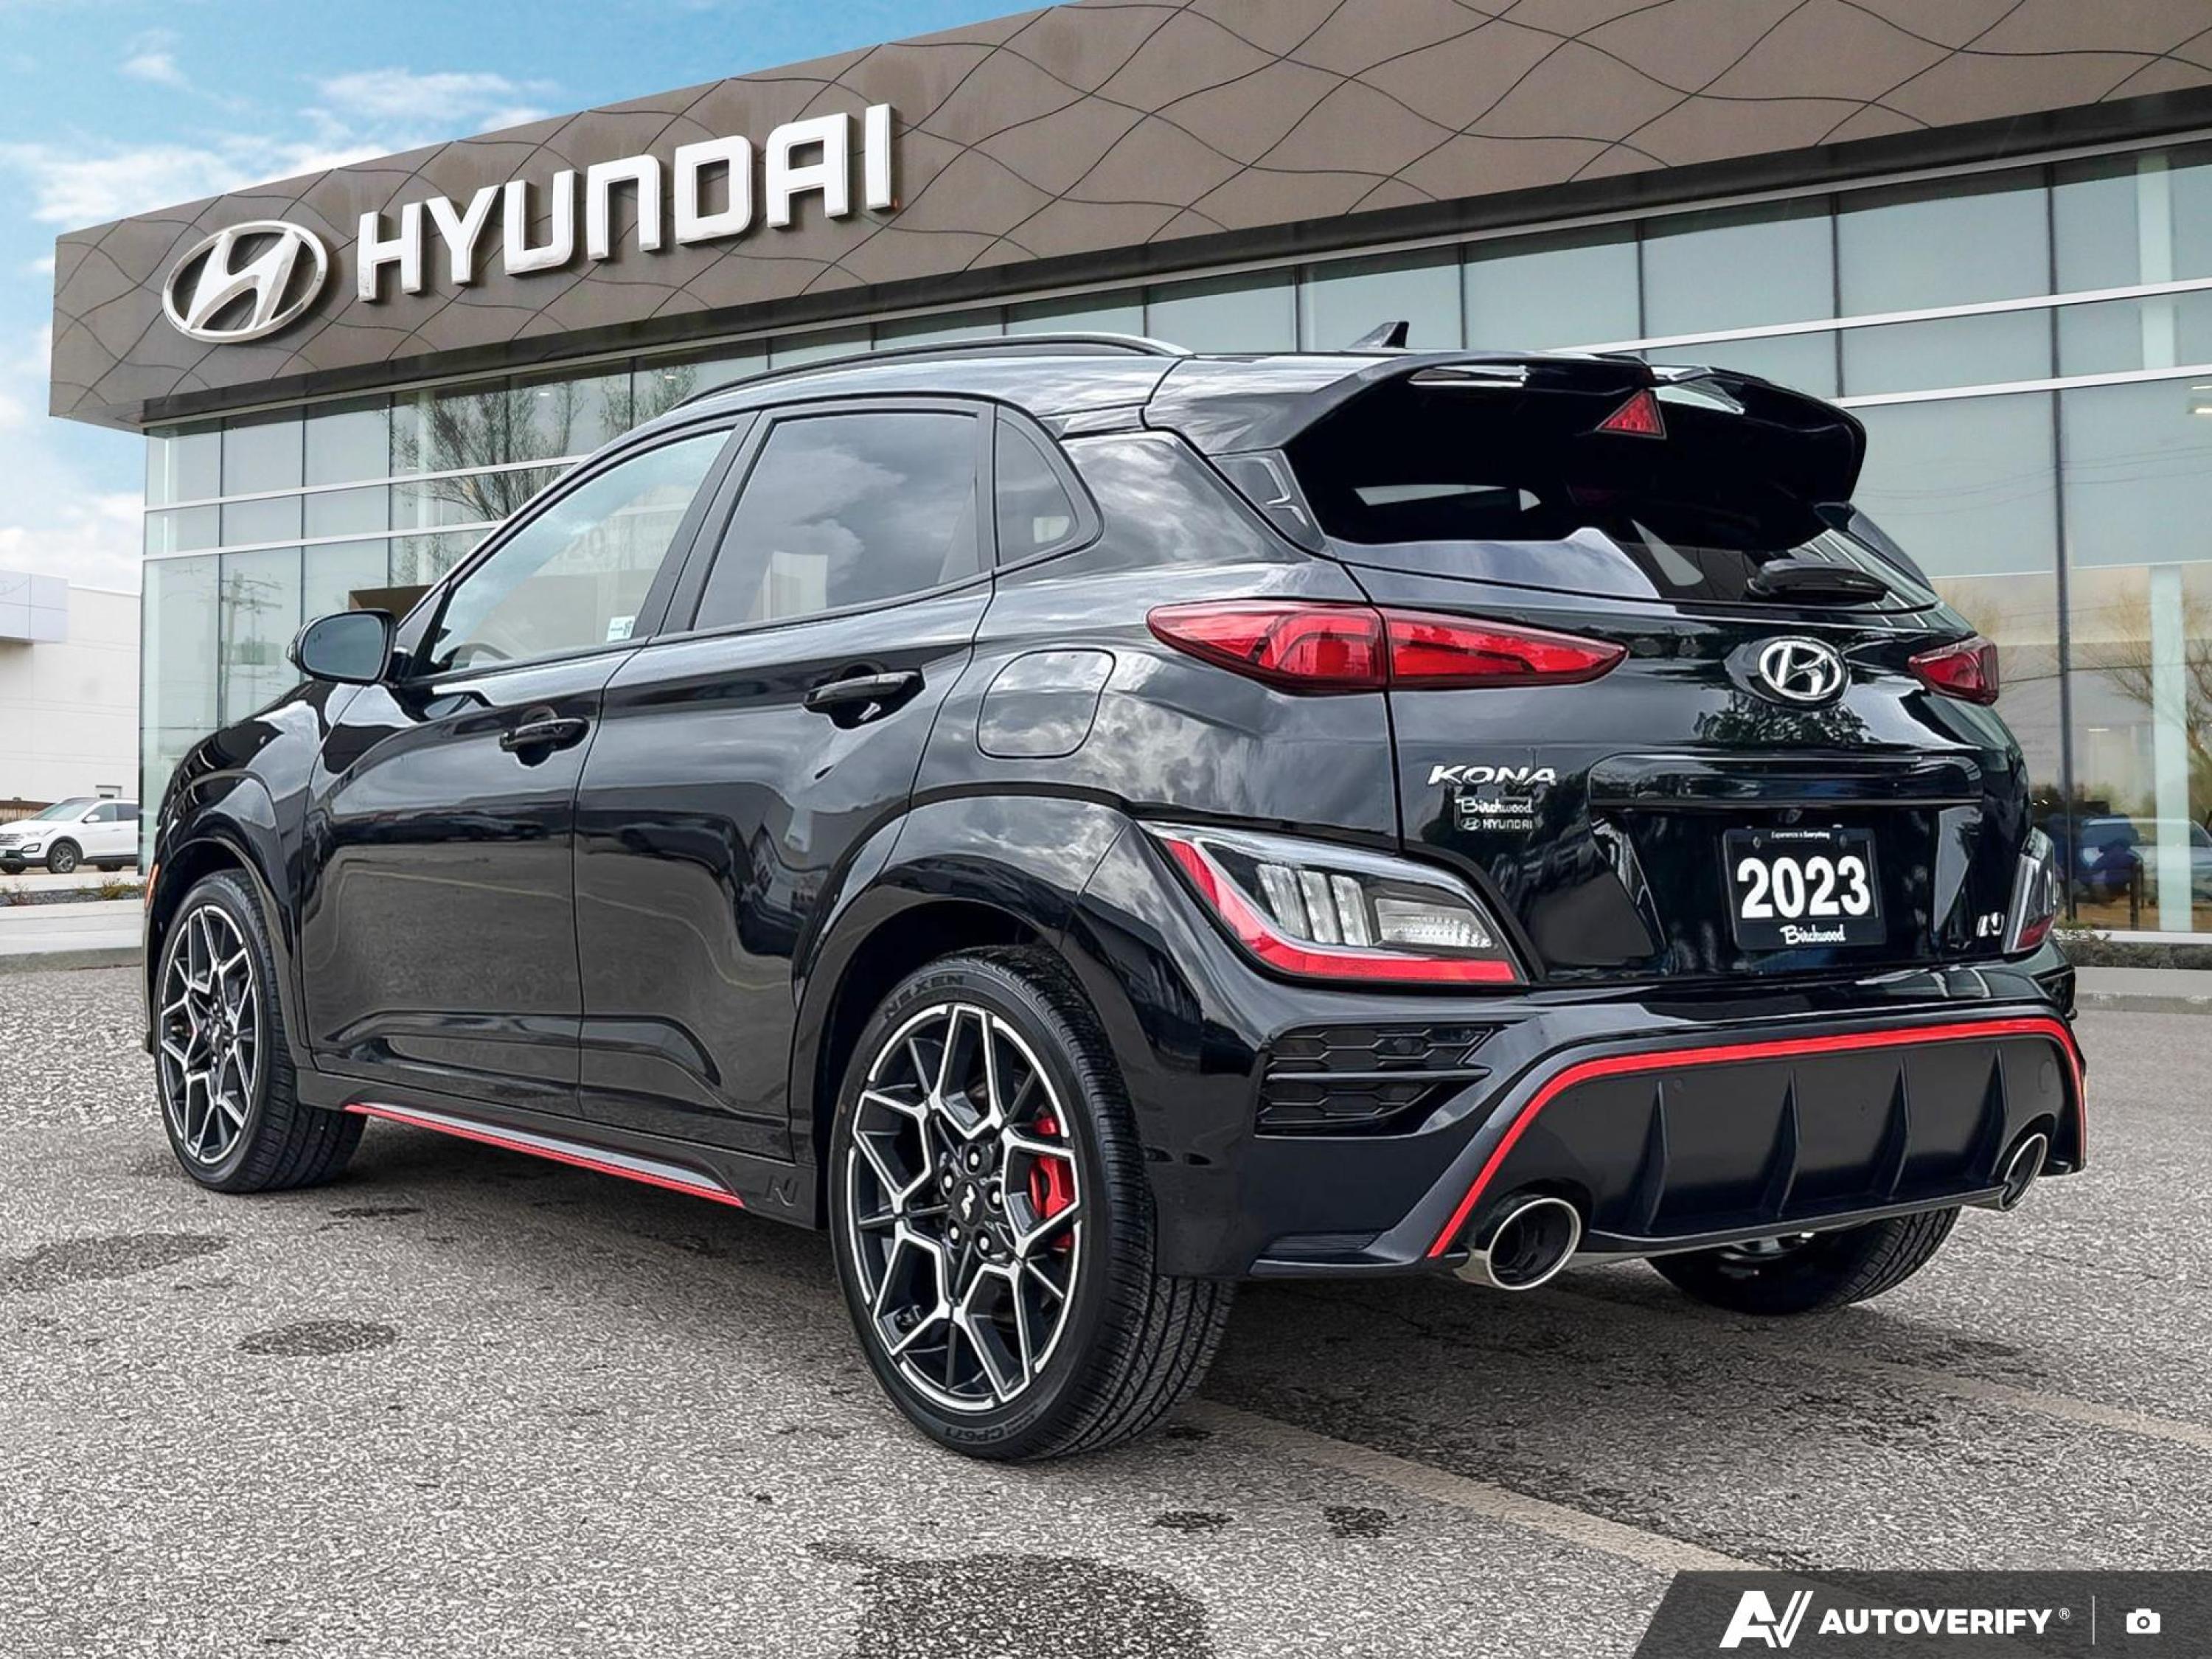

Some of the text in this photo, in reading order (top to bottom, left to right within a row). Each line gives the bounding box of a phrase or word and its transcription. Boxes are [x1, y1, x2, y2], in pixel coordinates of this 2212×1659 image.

[358, 102, 894, 302] HYUNDAI
[1427, 765, 1557, 785] KONA
[1455, 798, 1534, 813] Birchwood
[1483, 818, 1533, 830] HYUNDAI
[1737, 855, 1871, 919] 2023
